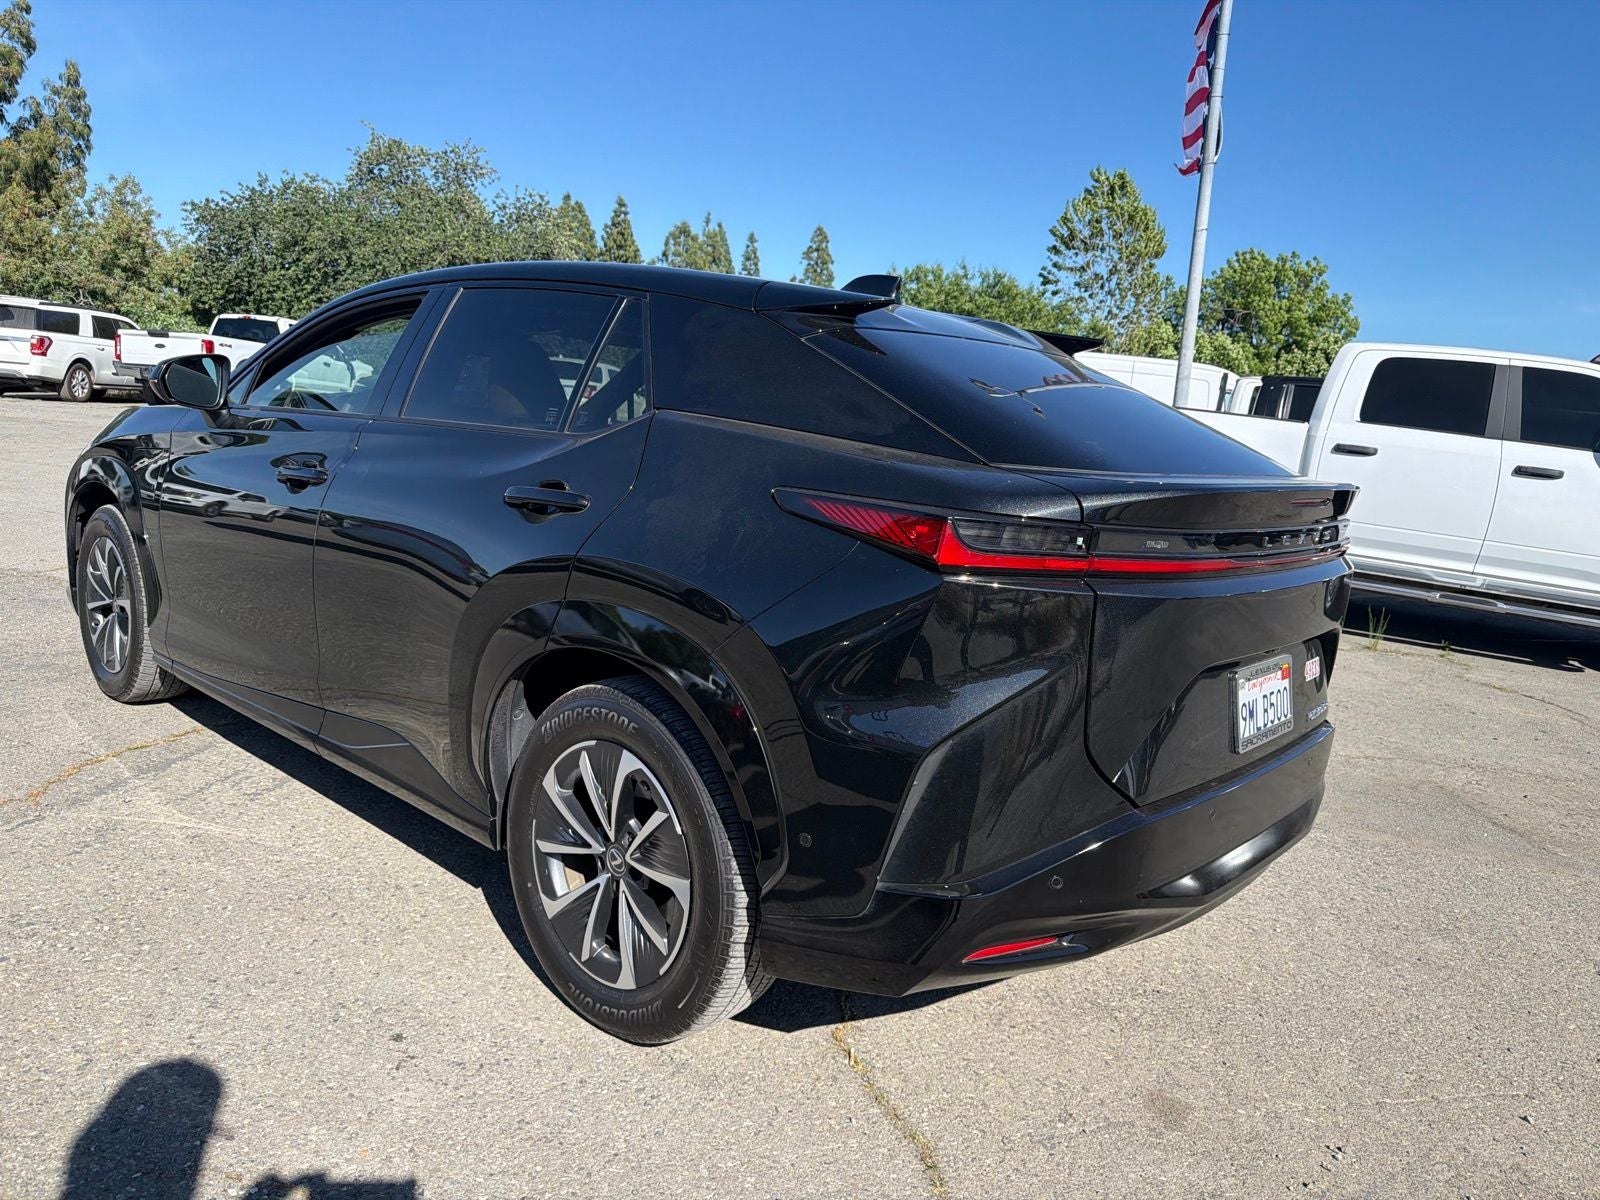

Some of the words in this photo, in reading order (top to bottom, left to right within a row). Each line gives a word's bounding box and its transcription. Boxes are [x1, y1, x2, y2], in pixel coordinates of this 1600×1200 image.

[541, 706, 640, 744] BRIDGESTONE
[1240, 686, 1289, 740] 9MLB500
[1240, 720, 1293, 751] SACRAMENTO
